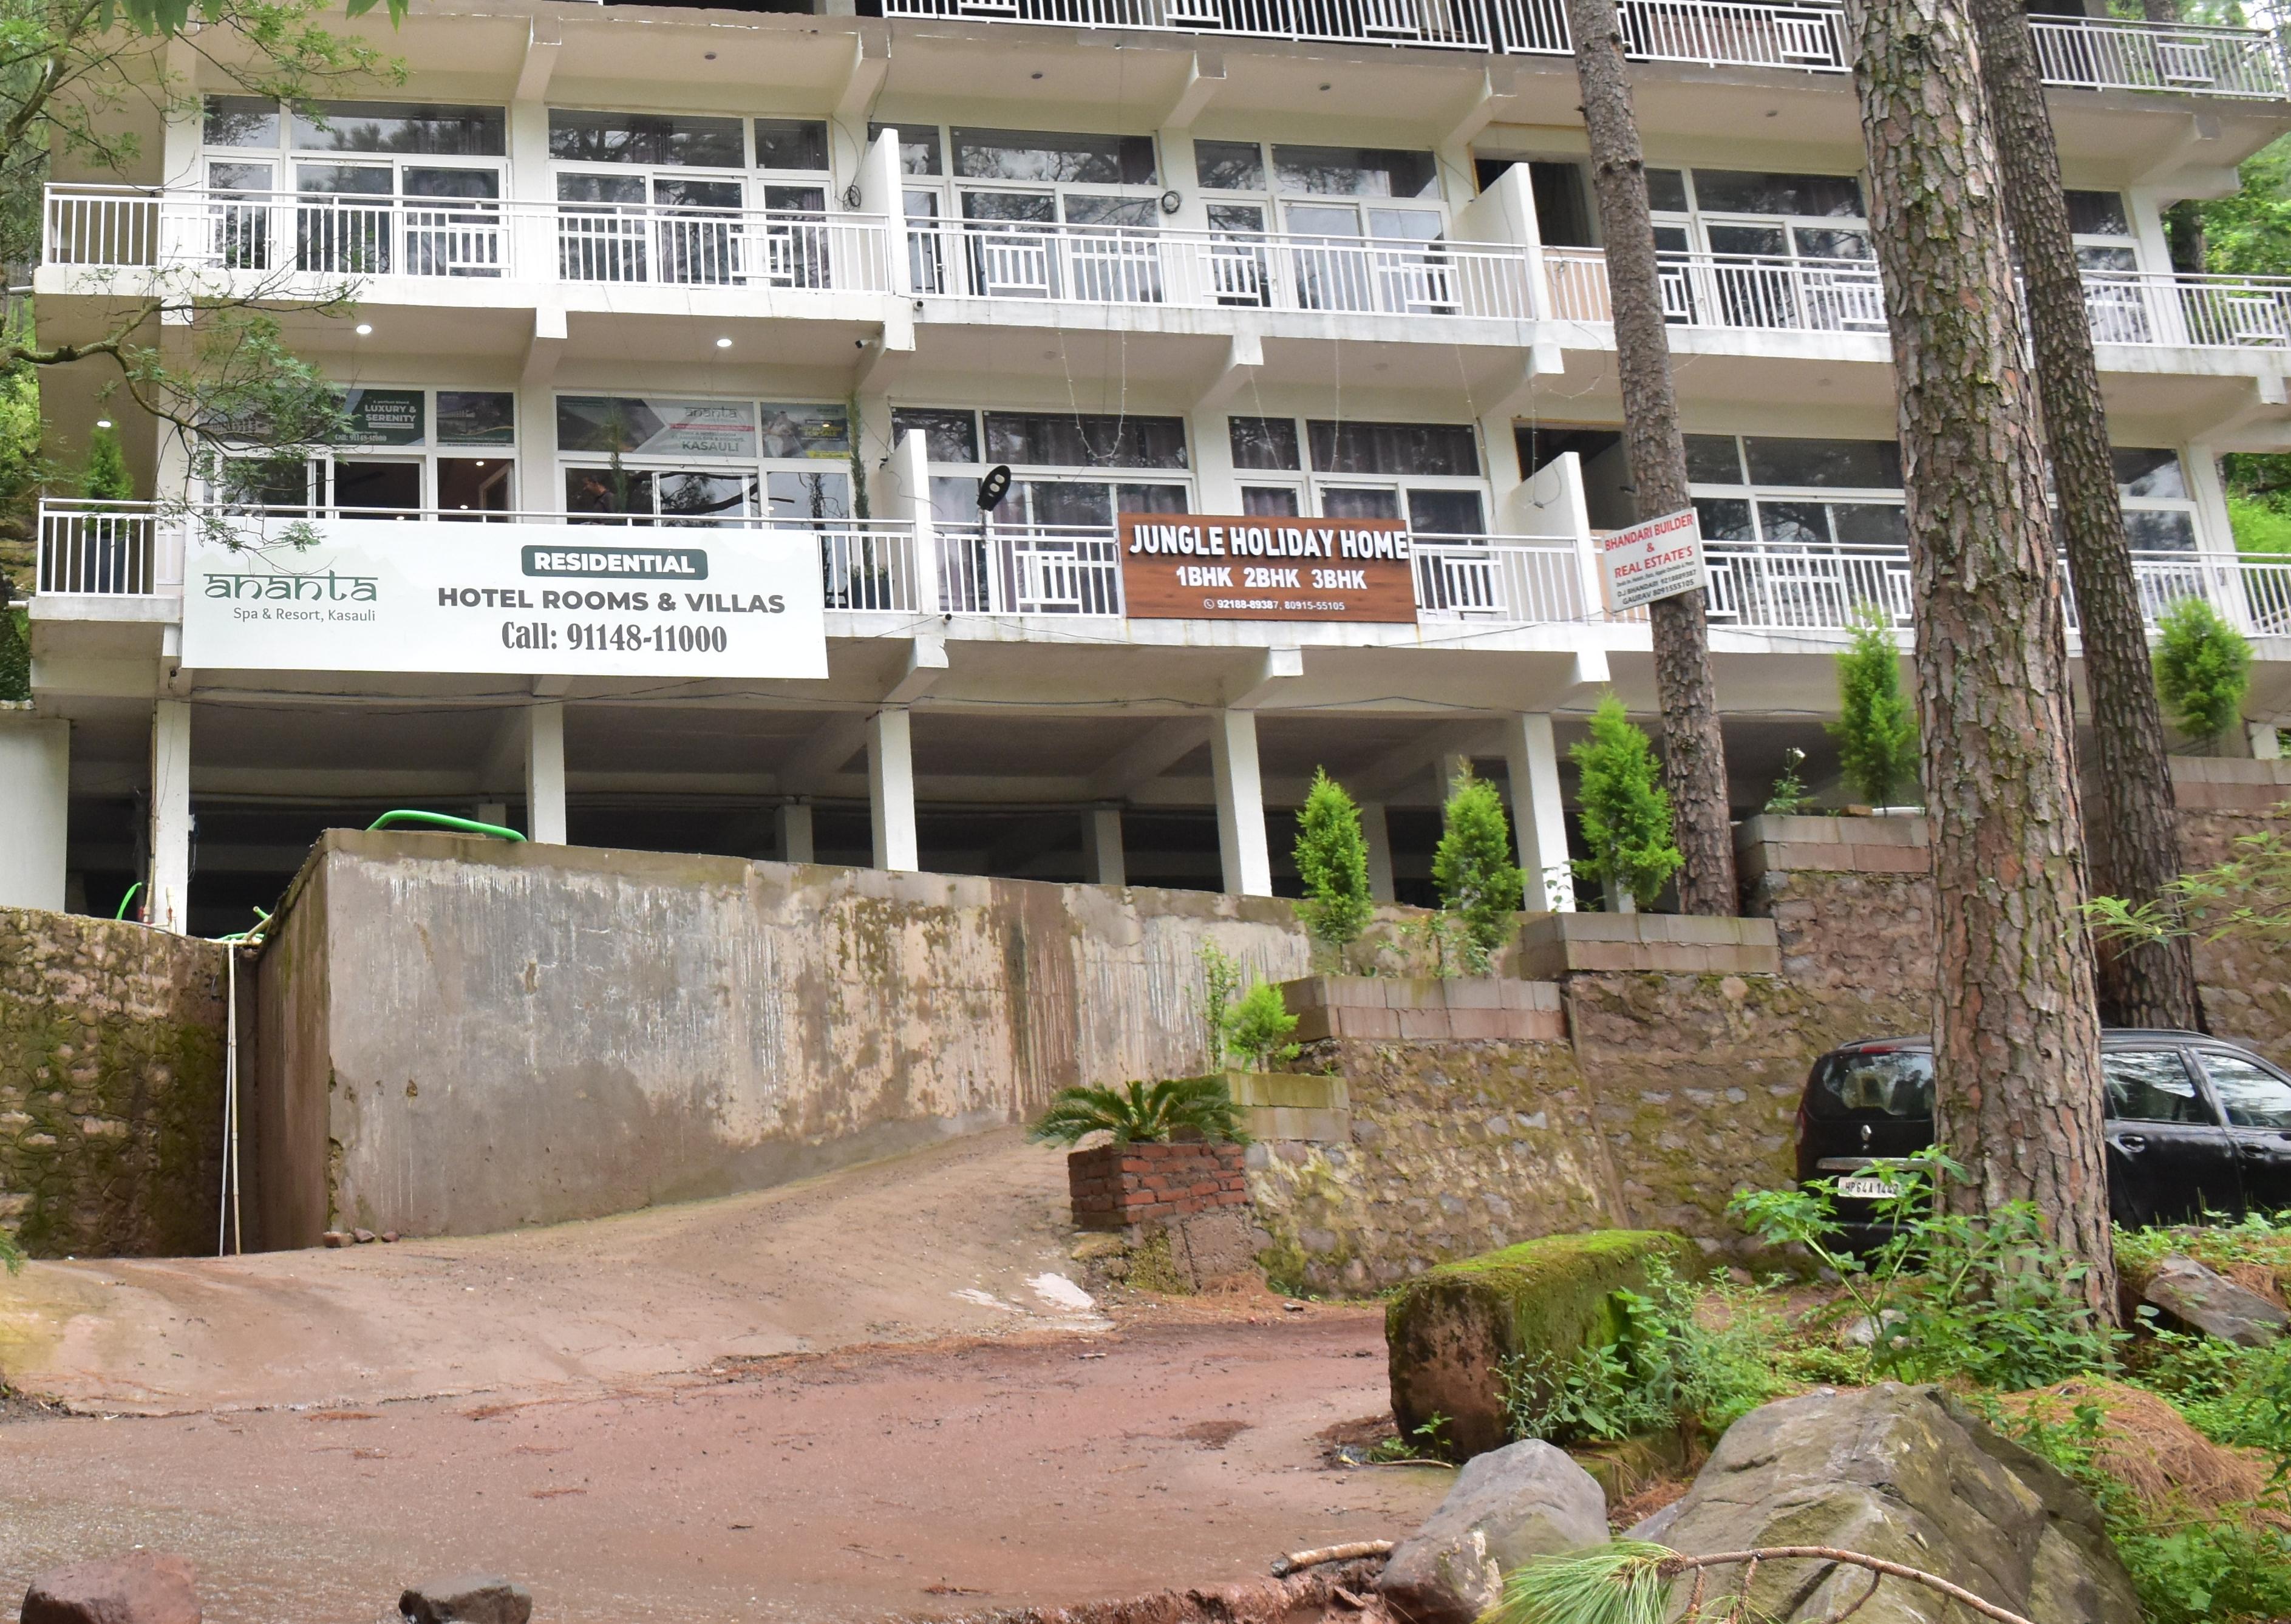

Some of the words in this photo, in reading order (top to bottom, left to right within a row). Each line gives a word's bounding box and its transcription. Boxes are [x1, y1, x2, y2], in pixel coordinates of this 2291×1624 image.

[364, 404, 406, 413] LUXURY
[683, 441, 739, 452] KASAULI
[1129, 525, 1224, 555] JUNGLE
[1230, 527, 1335, 558] HOLIDAY
[1340, 530, 1410, 559] HOME
[1605, 527, 1653, 551] BHANDARI
[1654, 514, 1694, 535] BUILDER
[1646, 542, 1655, 552] &
[534, 552, 696, 574] RESIDENTIAL
[1615, 562, 1643, 579] REAL
[203, 569, 378, 602] ananta
[1176, 566, 1233, 587] 1BHK
[1244, 567, 1301, 588] 2BHK
[1312, 569, 1367, 589] 3BHK
[438, 587, 534, 608] HOTEL
[542, 590, 649, 611] ROOMS
[657, 593, 676, 611] &
[684, 594, 785, 614] VILLAS
[1622, 591, 1652, 605] GAURAV
[1652, 579, 1695, 596] 8091555105
[233, 607, 258, 622] Spa
[262, 608, 272, 619] &
[276, 608, 325, 622] Resort,
[328, 609, 375, 622] Kasauli
[1284, 600, 1346, 611] 80915-55105
[502, 621, 557, 650] Call:
[567, 623, 727, 653] 91148-11000
